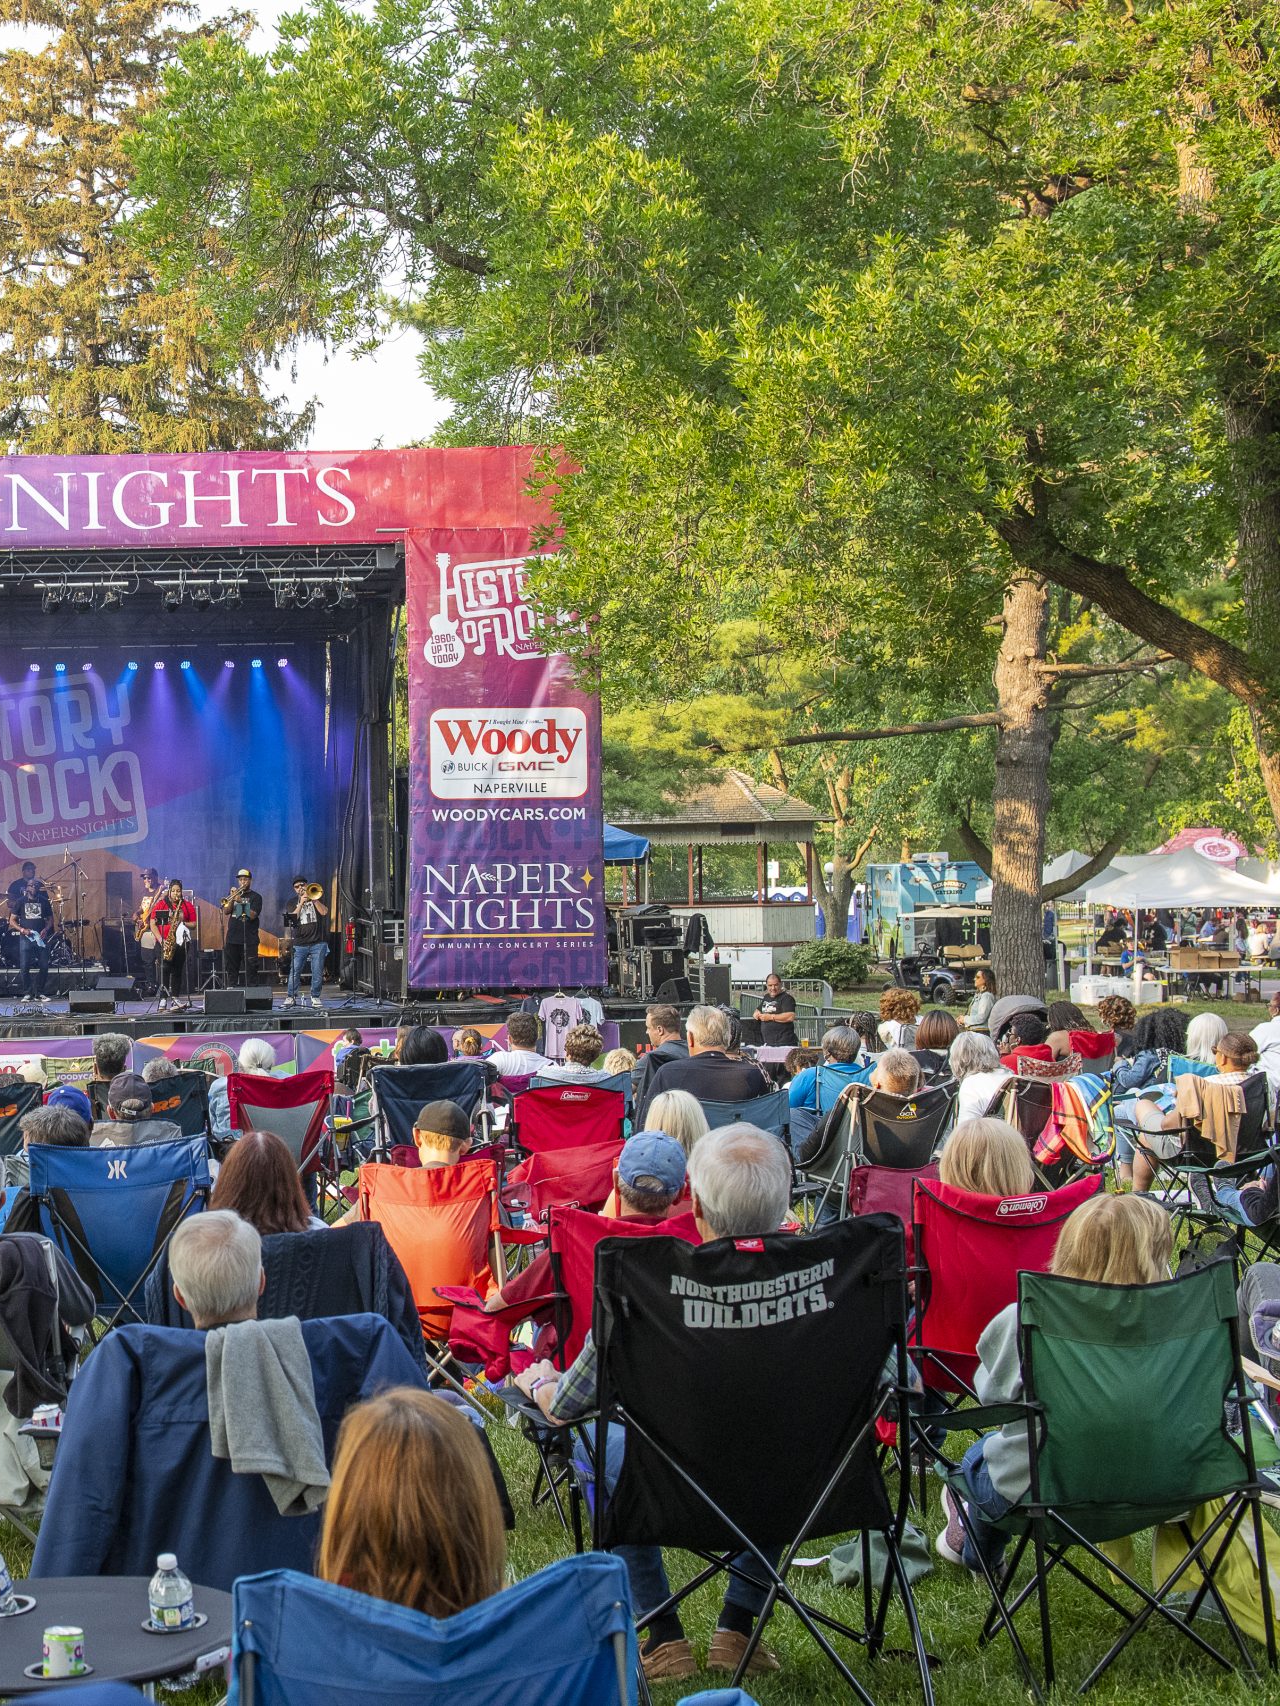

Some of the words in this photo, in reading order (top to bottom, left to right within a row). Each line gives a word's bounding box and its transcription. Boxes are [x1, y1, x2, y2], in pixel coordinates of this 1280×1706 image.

[4, 467, 357, 532] NIGHTS
[430, 633, 455, 645] 1960s
[462, 618, 492, 655] OF
[431, 645, 443, 655] UP
[444, 644, 454, 653] TO
[433, 653, 459, 664] TODAY
[434, 718, 583, 763] Woody
[457, 762, 488, 772] BUICK
[497, 760, 555, 772] GMC
[473, 782, 547, 794] NAPERVILLE
[431, 807, 586, 822] WOODYCARS.COM
[18, 826, 71, 844] NAPER
[75, 816, 136, 838] NIGHTS
[422, 862, 581, 895] NAPER
[422, 897, 595, 930] NIGHTS
[422, 942, 491, 950] COMMUNITY
[498, 941, 549, 949] CONCERT
[1008, 1199, 1044, 1213] Coleman
[670, 1258, 835, 1304] NORTHWESTERN
